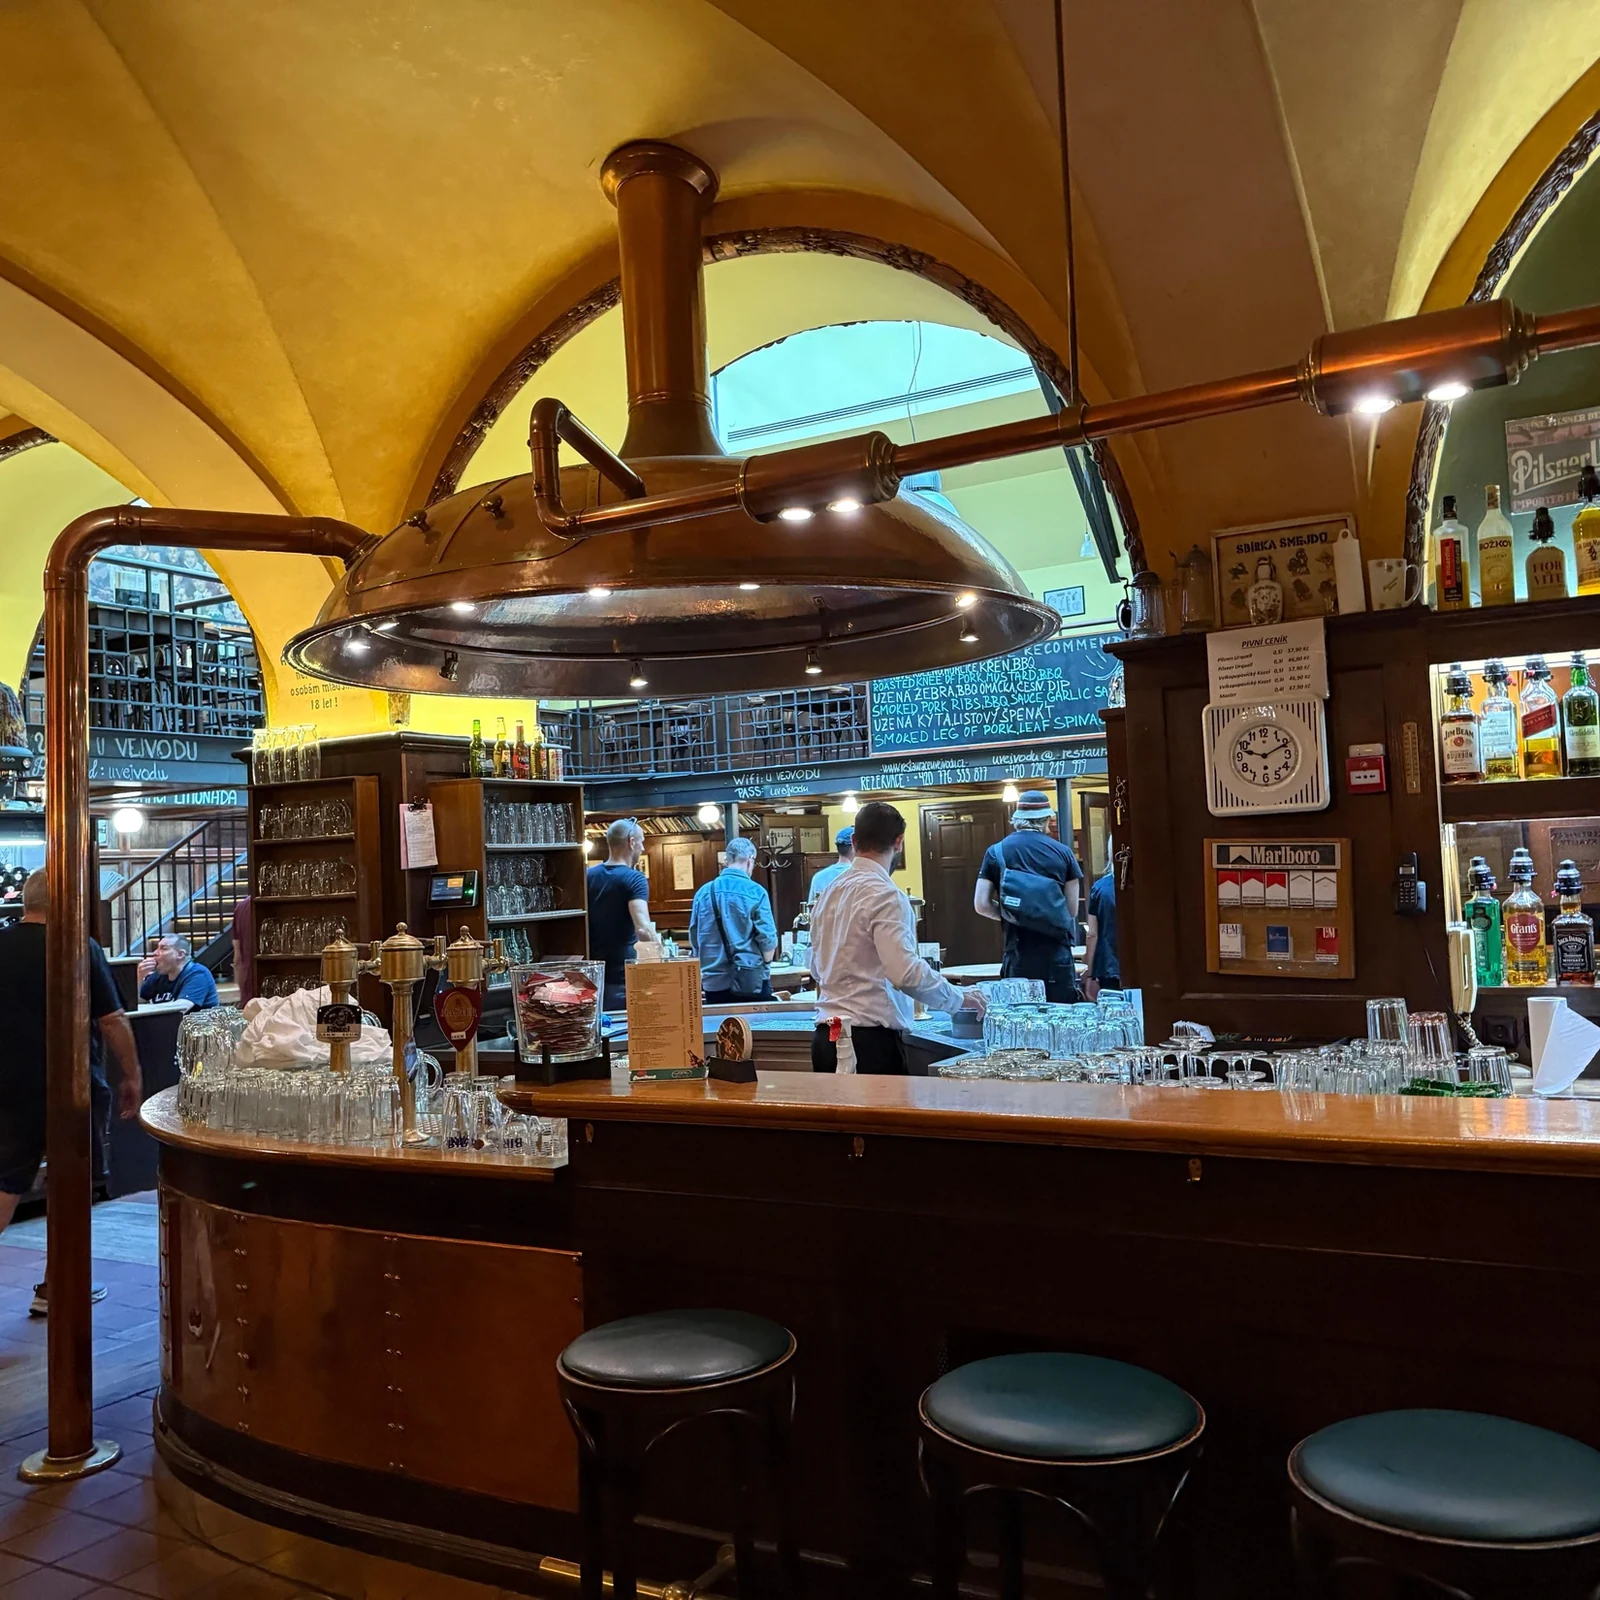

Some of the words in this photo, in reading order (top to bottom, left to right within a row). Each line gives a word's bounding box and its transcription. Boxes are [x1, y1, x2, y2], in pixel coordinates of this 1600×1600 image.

[1510, 449, 1591, 496] Pilsner
[873, 678, 915, 693] ROASTED
[916, 675, 942, 687] KNEE
[945, 674, 957, 684] OF
[1048, 680, 1070, 692] DIP
[310, 699, 320, 710] 18
[322, 698, 332, 709] let
[872, 703, 918, 717] SMOKED
[921, 700, 949, 713] PORK
[1046, 688, 1091, 702] GARLIC
[874, 730, 929, 747] SMOKED
[933, 727, 959, 741] LEG
[964, 725, 978, 737] OF
[1248, 731, 1256, 741] 11
[1259, 728, 1268, 738] 12
[115, 737, 198, 761] VEJVODU
[1239, 740, 1248, 750] 10
[1236, 752, 1243, 762] 9
[1284, 749, 1291, 759] 3
[1241, 762, 1248, 772] 8
[1282, 761, 1290, 771] 4
[1262, 773, 1270, 783] 6
[1274, 770, 1281, 780] 5
[1252, 846, 1320, 865] Marlboro
[1510, 922, 1538, 934] Grant's
